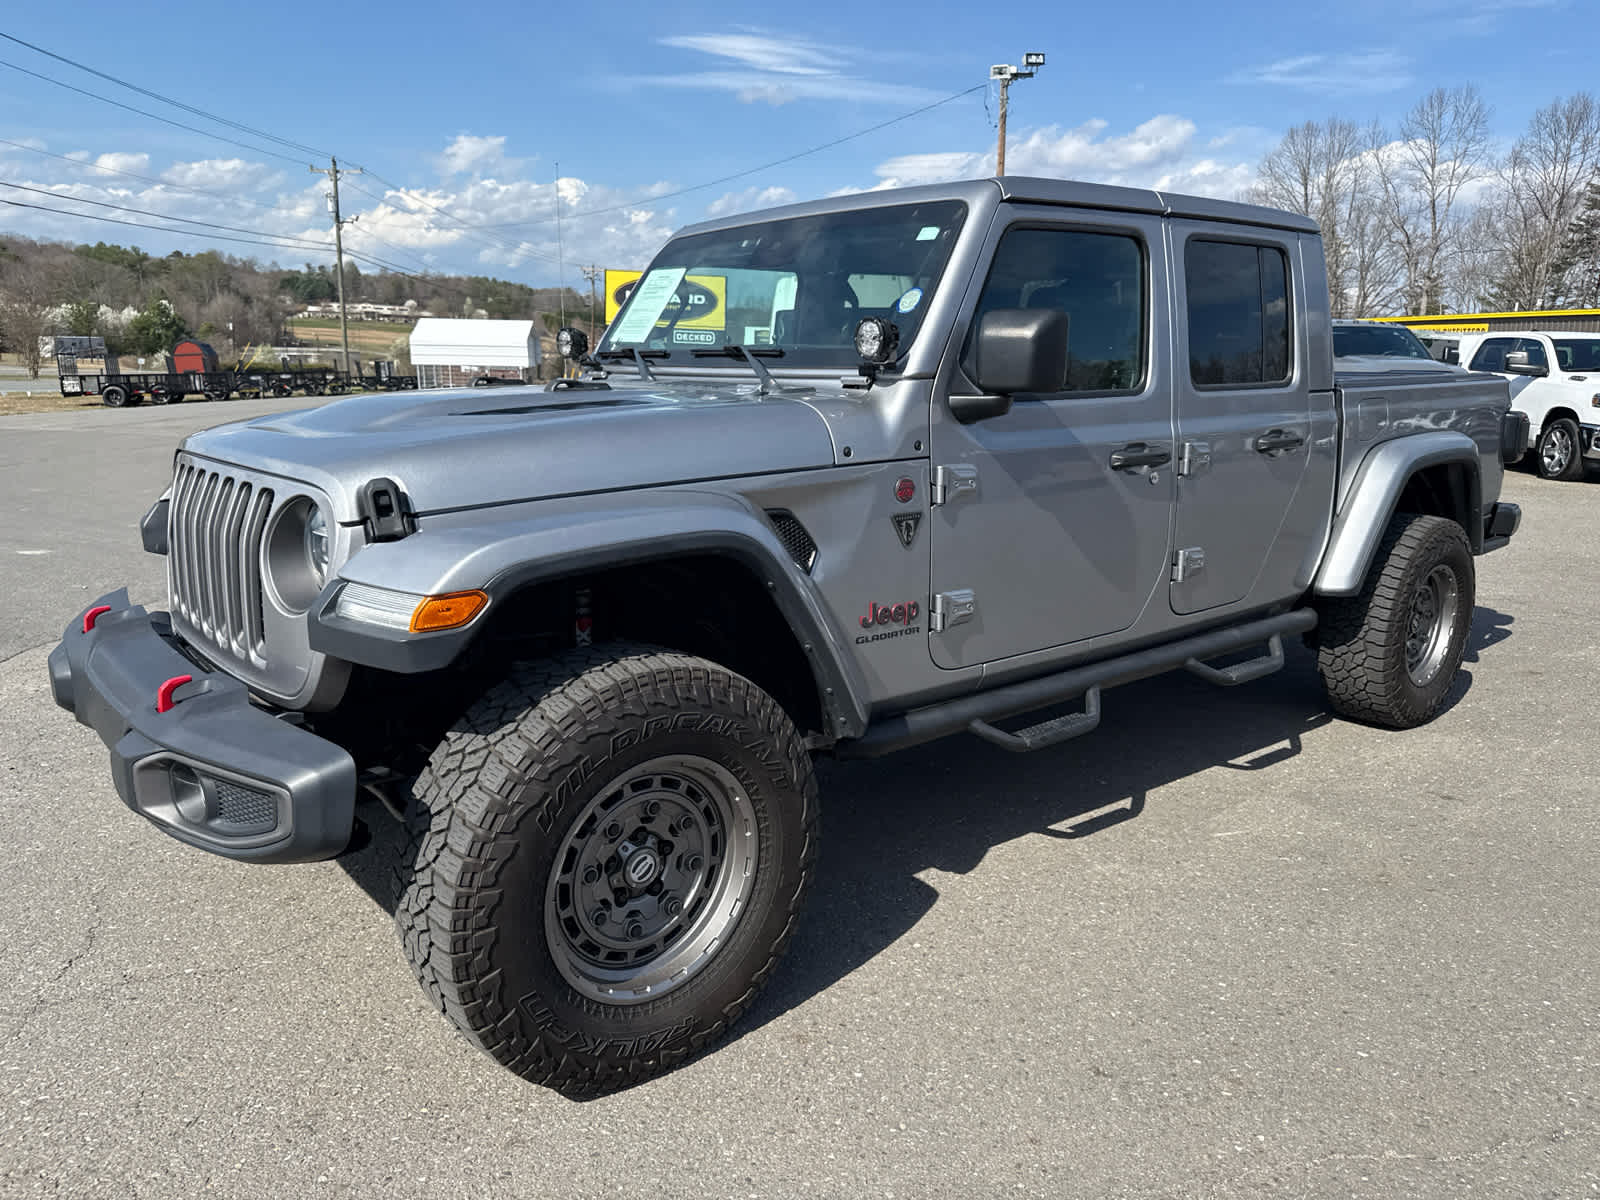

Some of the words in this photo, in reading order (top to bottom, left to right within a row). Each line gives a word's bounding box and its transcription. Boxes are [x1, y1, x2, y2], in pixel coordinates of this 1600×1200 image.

[676, 332, 713, 342] DECKED
[859, 600, 919, 628] Jeep
[855, 627, 920, 645] GLADIATOR
